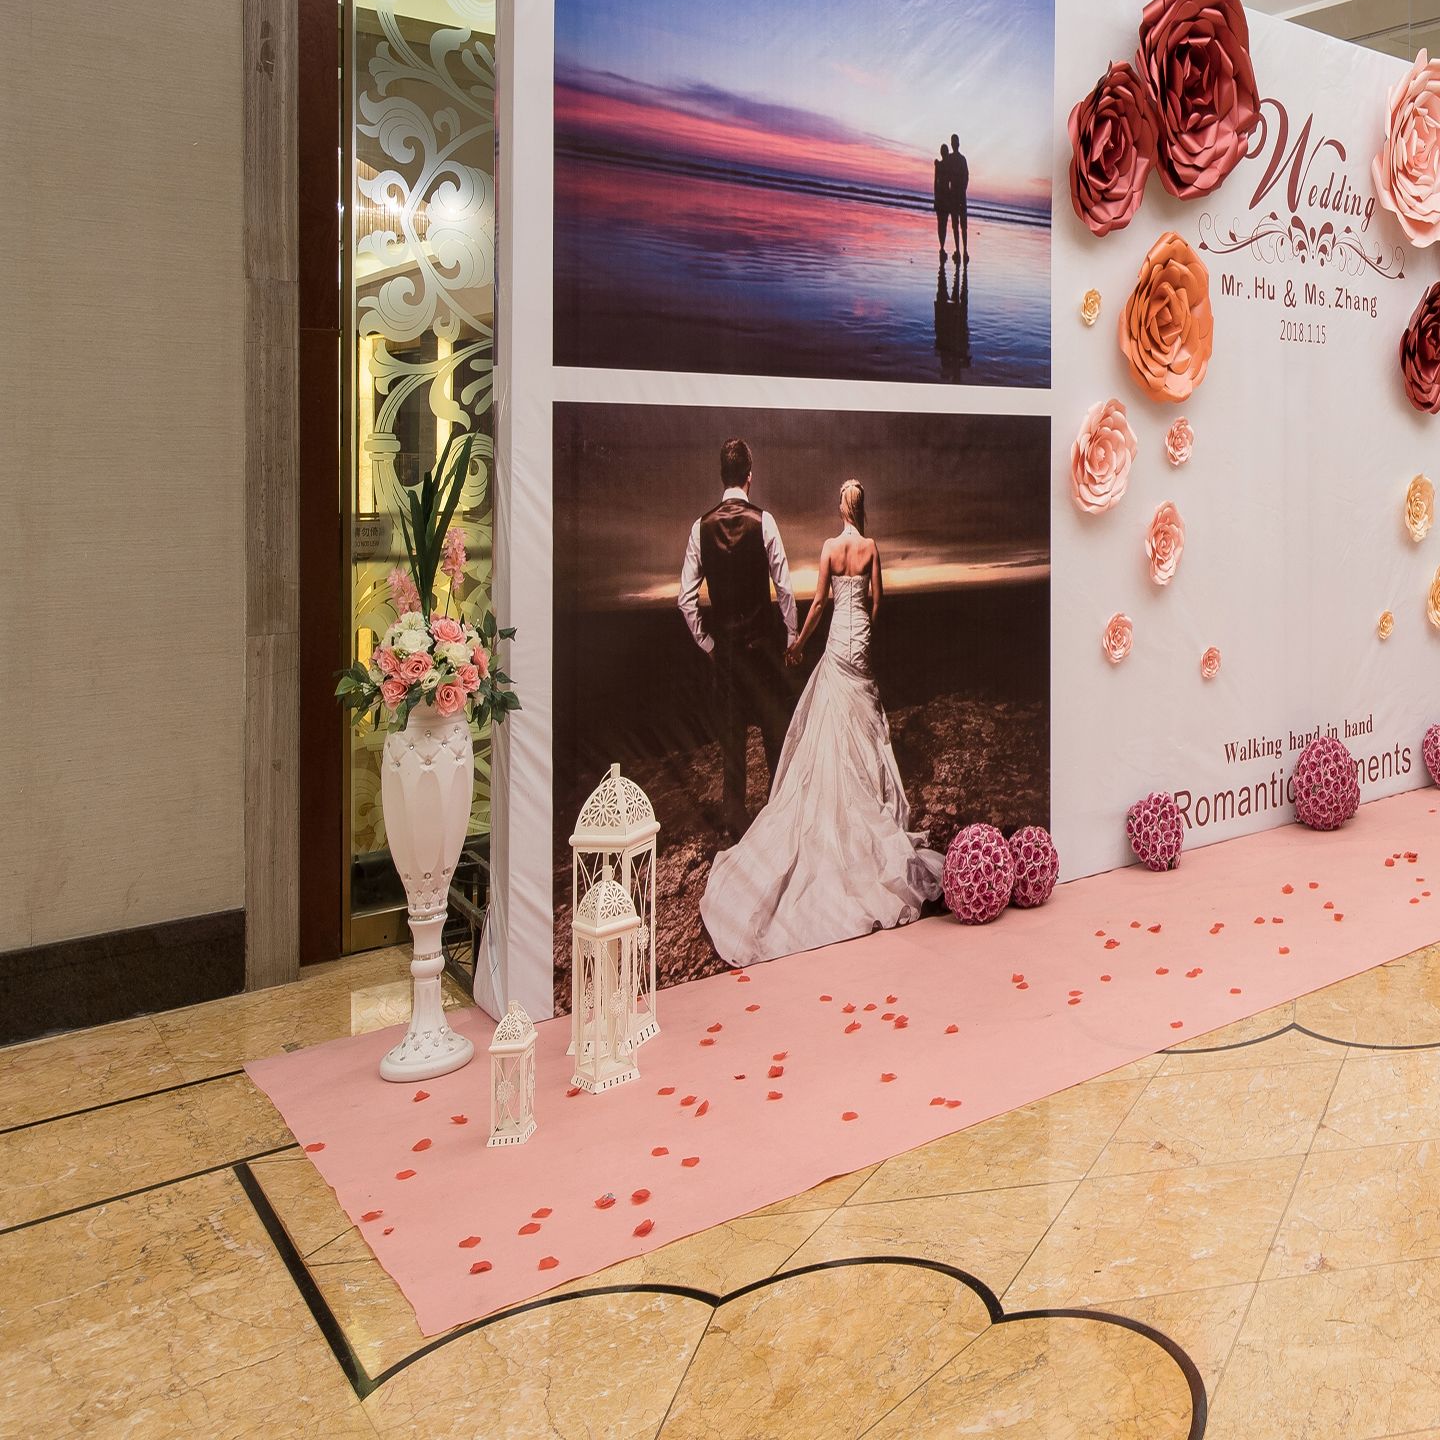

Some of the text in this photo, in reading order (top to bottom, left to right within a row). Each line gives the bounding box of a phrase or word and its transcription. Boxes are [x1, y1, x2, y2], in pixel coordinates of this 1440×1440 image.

[1244, 97, 1376, 233] Wedding
[1221, 273, 1378, 319] Mr.Hu & Ms.Zhang
[1279, 319, 1326, 344] 2018.1.15
[1223, 713, 1373, 765] Walking hand in hand
